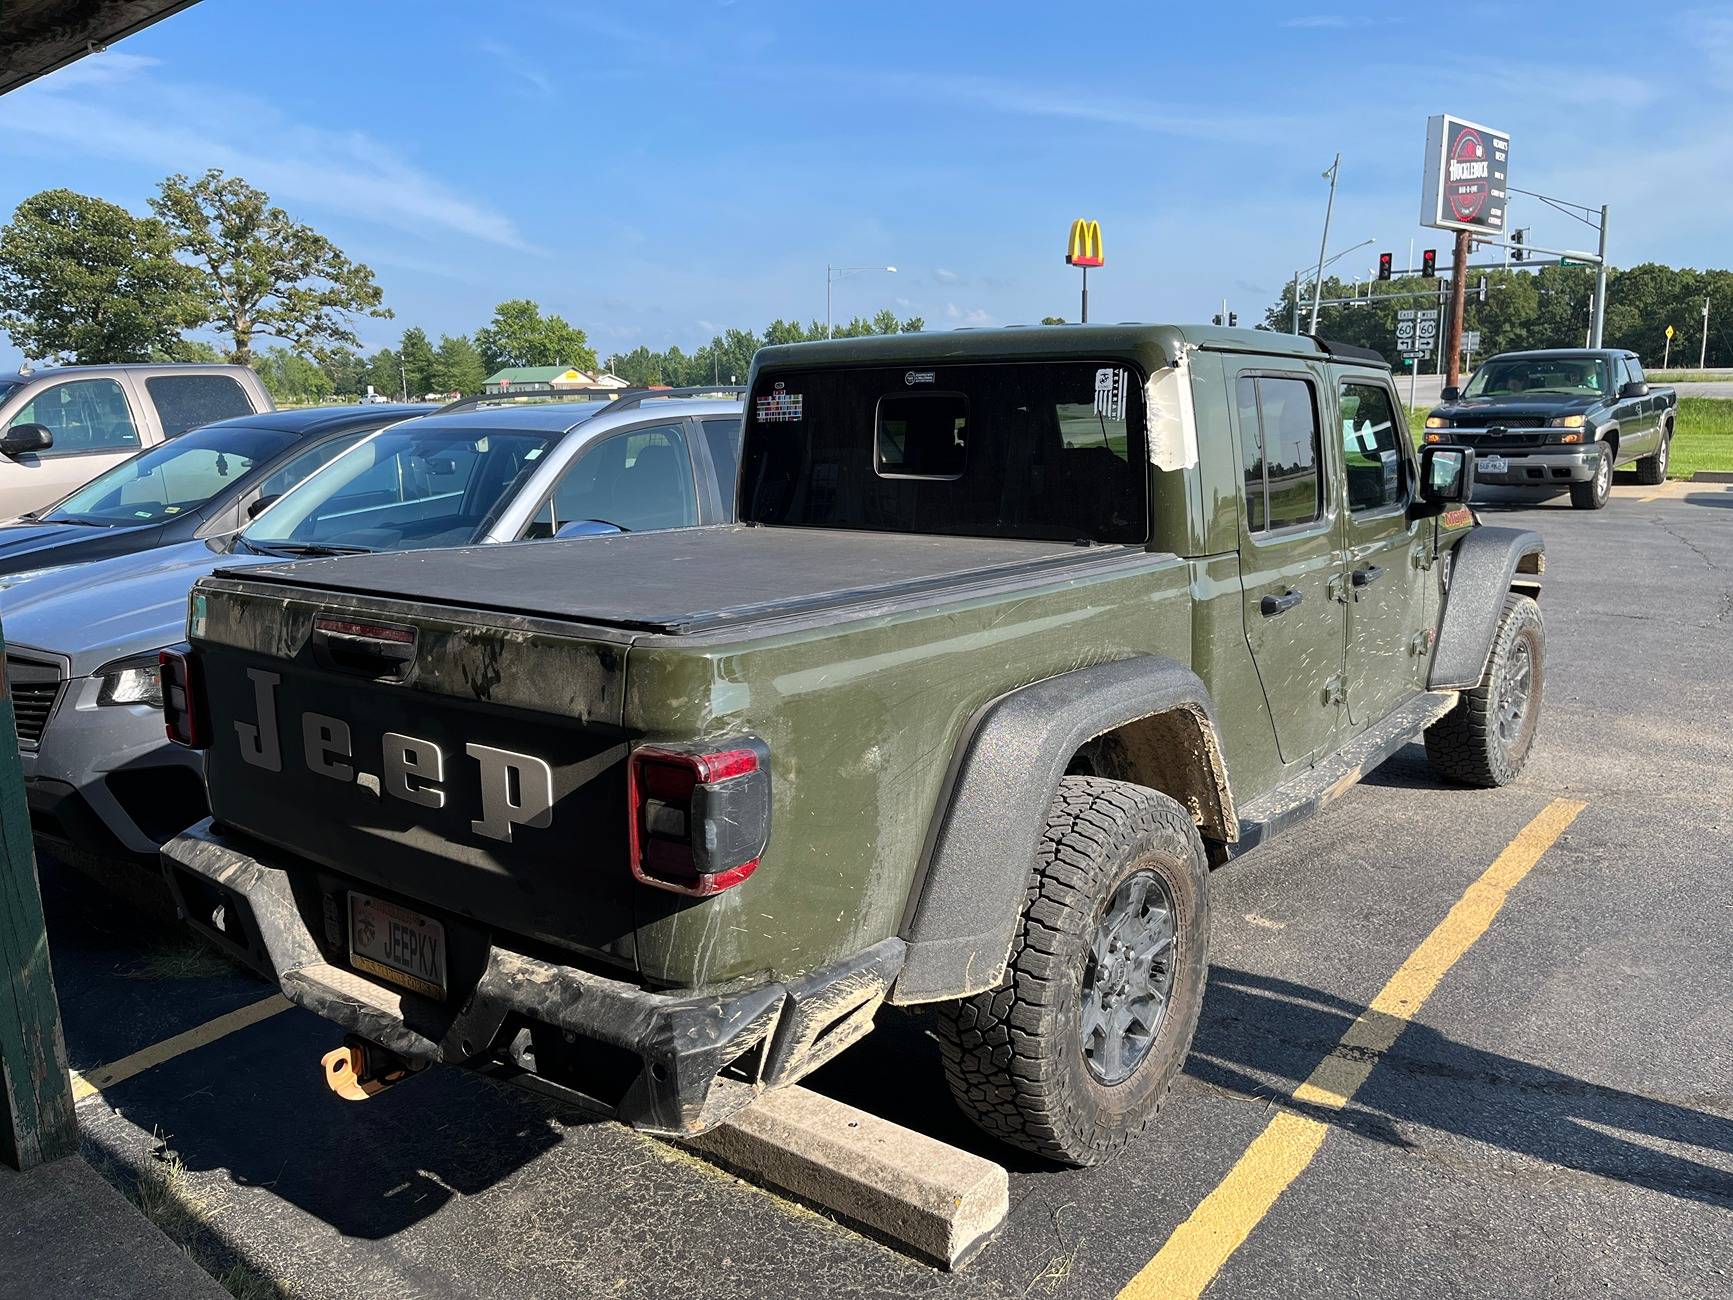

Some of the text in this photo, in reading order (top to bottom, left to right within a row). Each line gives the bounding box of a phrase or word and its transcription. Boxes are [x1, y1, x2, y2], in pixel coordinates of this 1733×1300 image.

[1398, 325, 1411, 335] 60
[1421, 324, 1434, 335] 60
[233, 667, 554, 843] Jeep
[384, 920, 438, 977] JEEPKX
